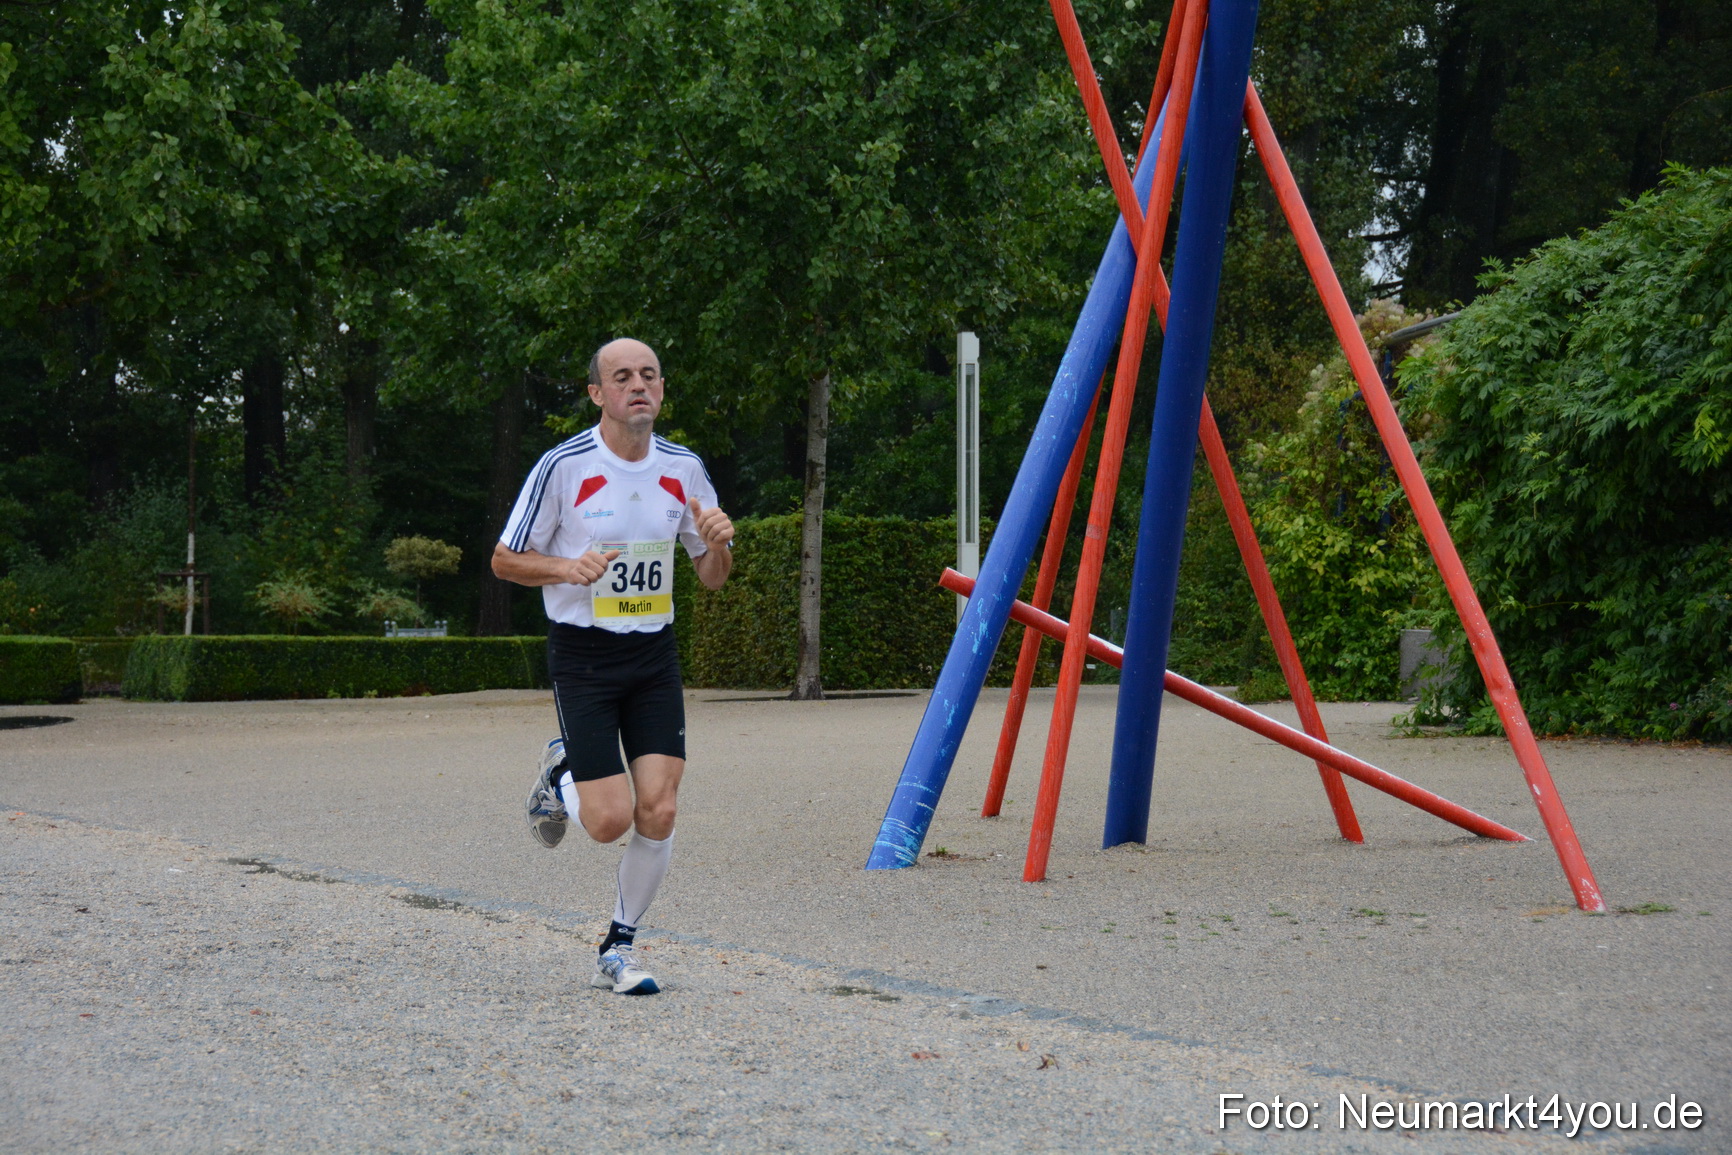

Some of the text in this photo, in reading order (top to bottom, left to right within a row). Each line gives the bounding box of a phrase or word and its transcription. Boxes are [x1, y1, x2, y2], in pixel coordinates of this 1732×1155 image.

[634, 541, 669, 553] BOCK
[611, 560, 662, 593] 346
[618, 600, 652, 614] Martin
